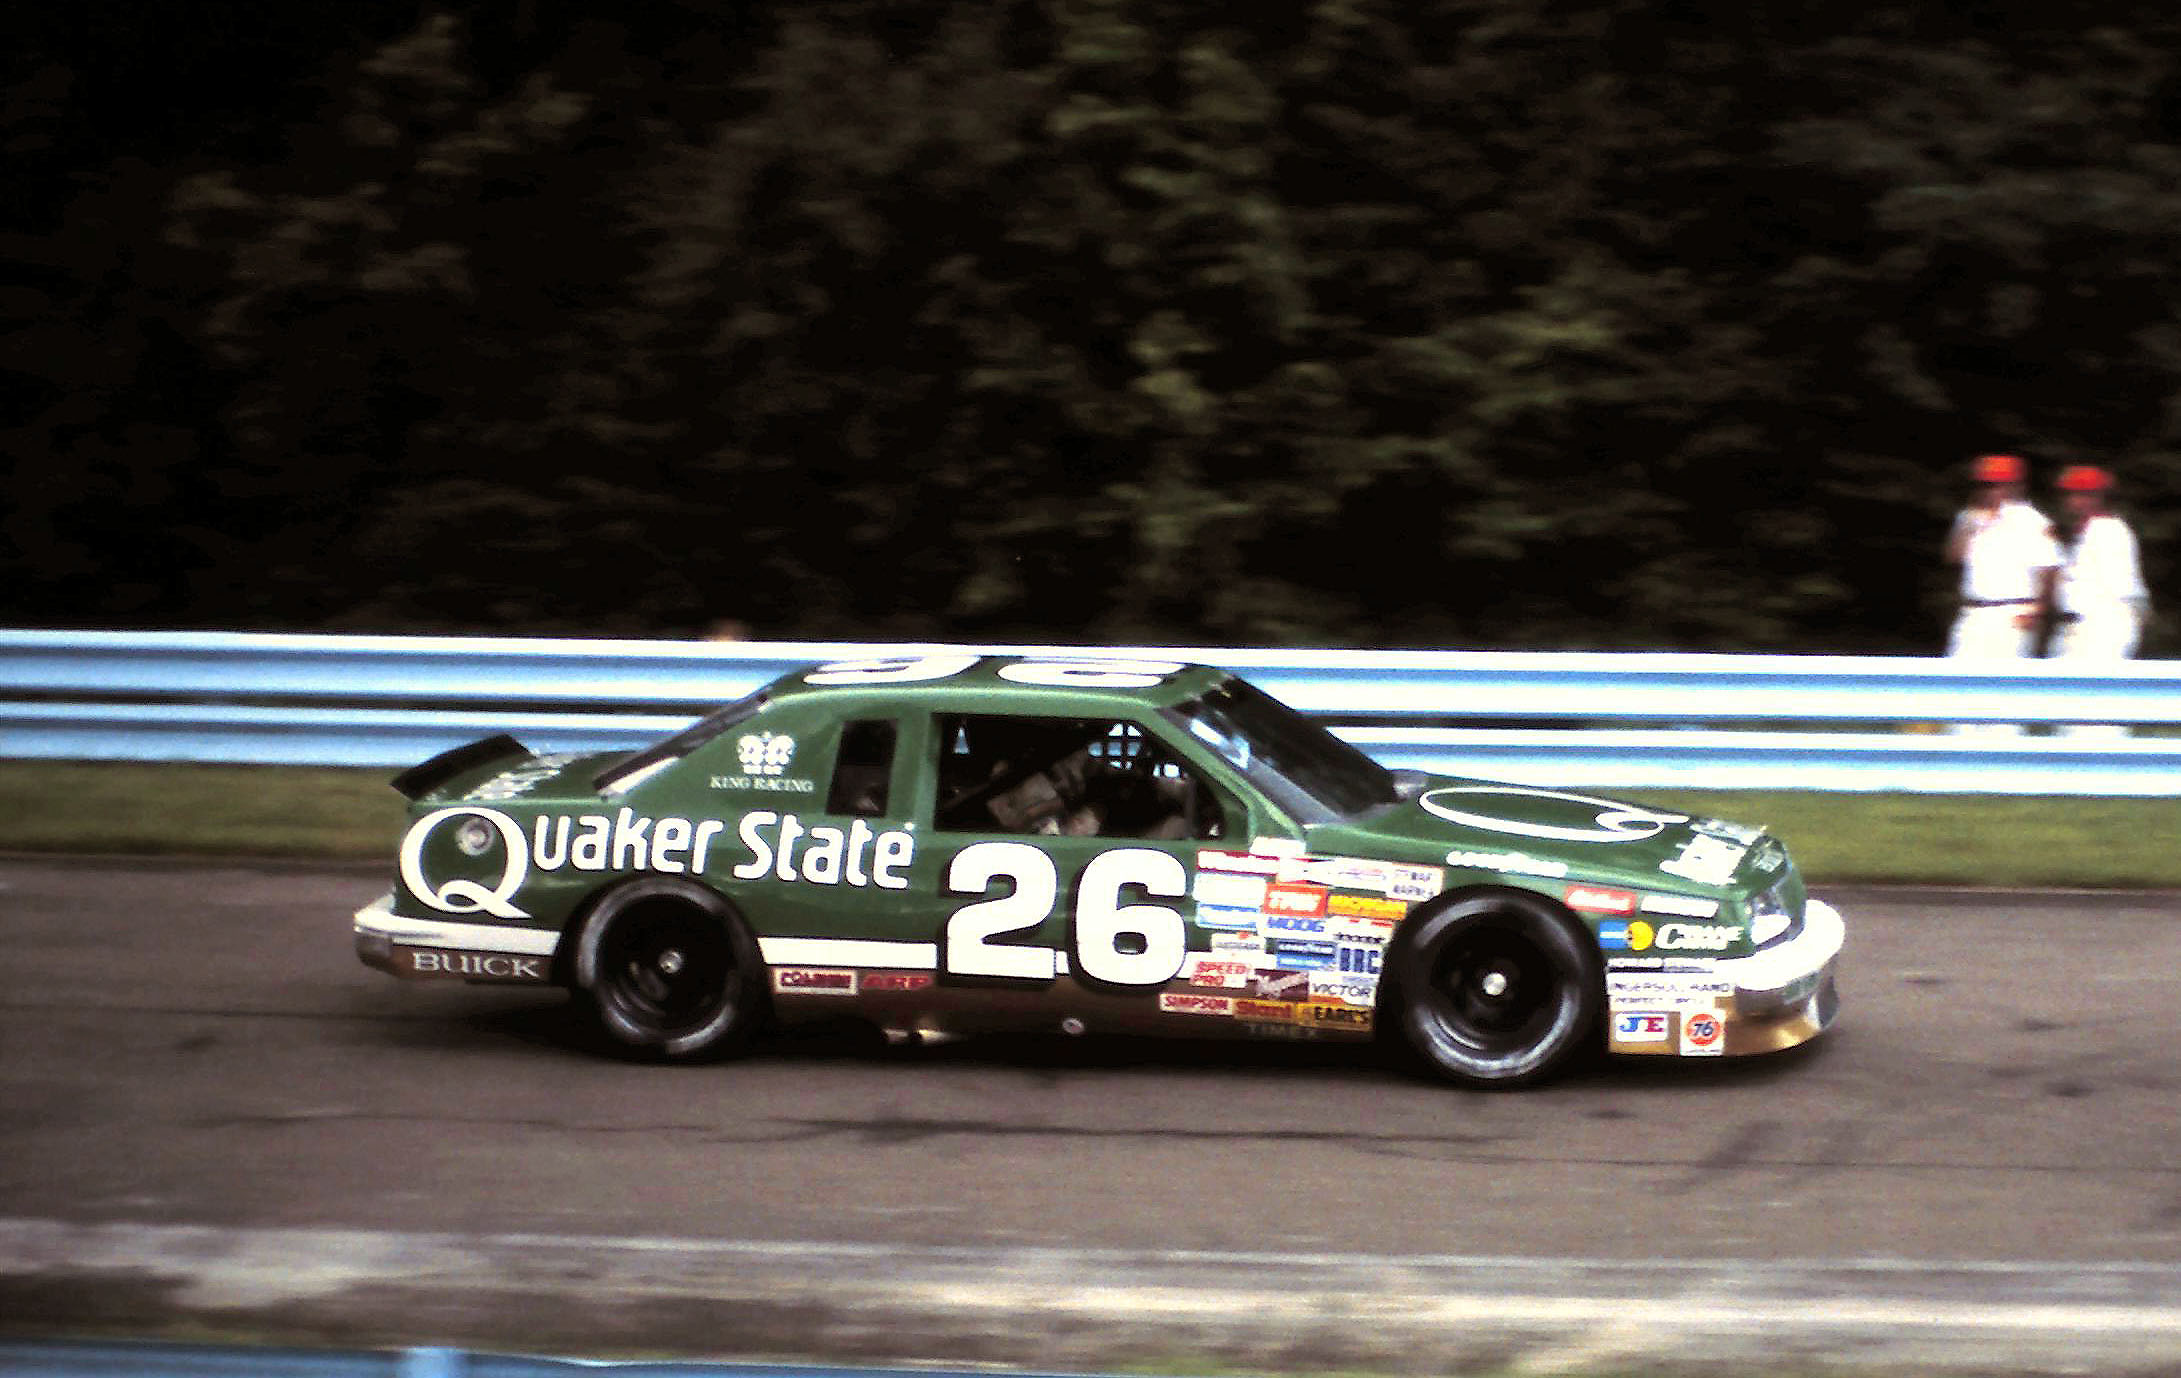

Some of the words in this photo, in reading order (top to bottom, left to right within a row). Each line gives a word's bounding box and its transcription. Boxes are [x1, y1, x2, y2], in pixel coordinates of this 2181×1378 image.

[709, 775, 752, 789] KING
[753, 778, 814, 793] RACING
[400, 806, 724, 919] Quaker
[732, 810, 914, 890] State
[945, 842, 1188, 986] 26
[413, 951, 542, 978] BUICK
[1311, 982, 1373, 998] VICTOR
[1164, 995, 1229, 1011] SIMPSON
[1692, 1021, 1715, 1037] 76
